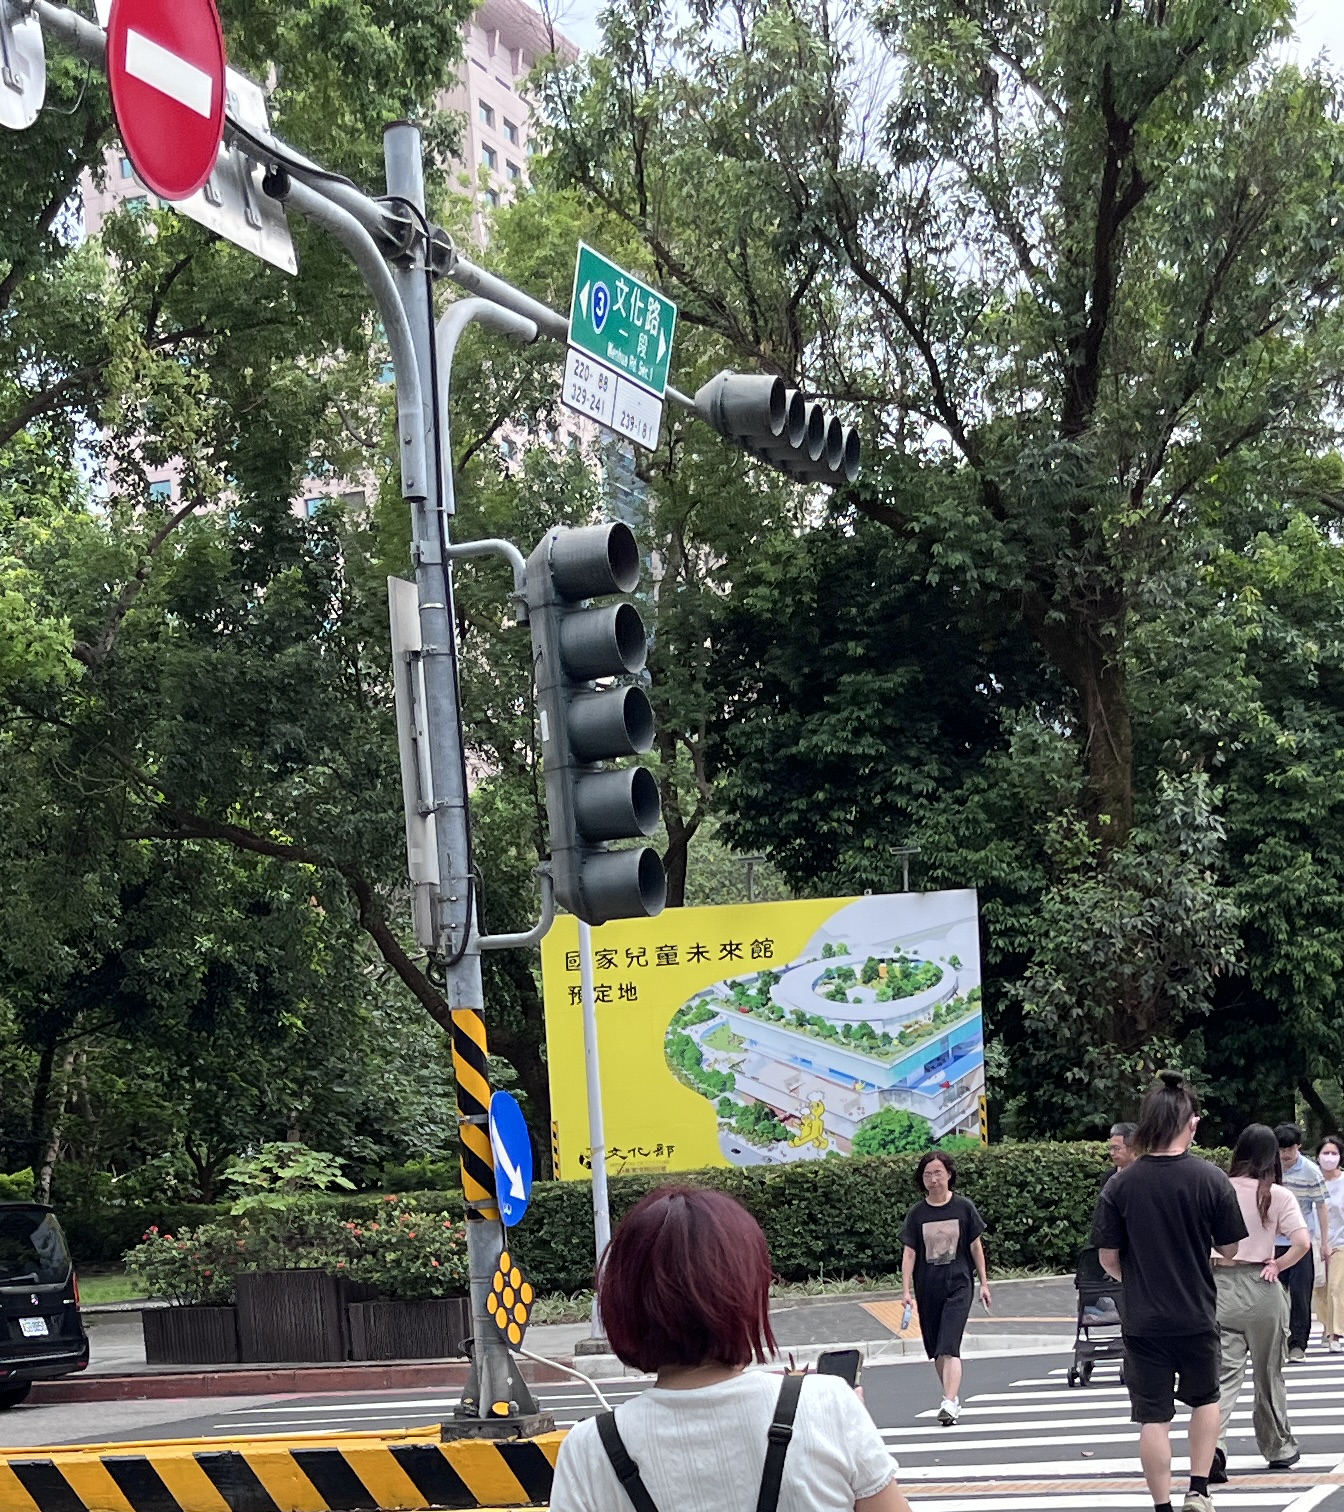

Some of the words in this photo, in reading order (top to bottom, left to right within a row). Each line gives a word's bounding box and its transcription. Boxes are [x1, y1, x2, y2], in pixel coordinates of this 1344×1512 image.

[595, 291, 605, 317] 3
[613, 278, 661, 337] 文化路
[619, 329, 648, 360] 一段
[565, 938, 775, 972] 國家兒童未來館
[568, 981, 638, 1006] 預定地
[605, 1143, 675, 1159] 文化部
